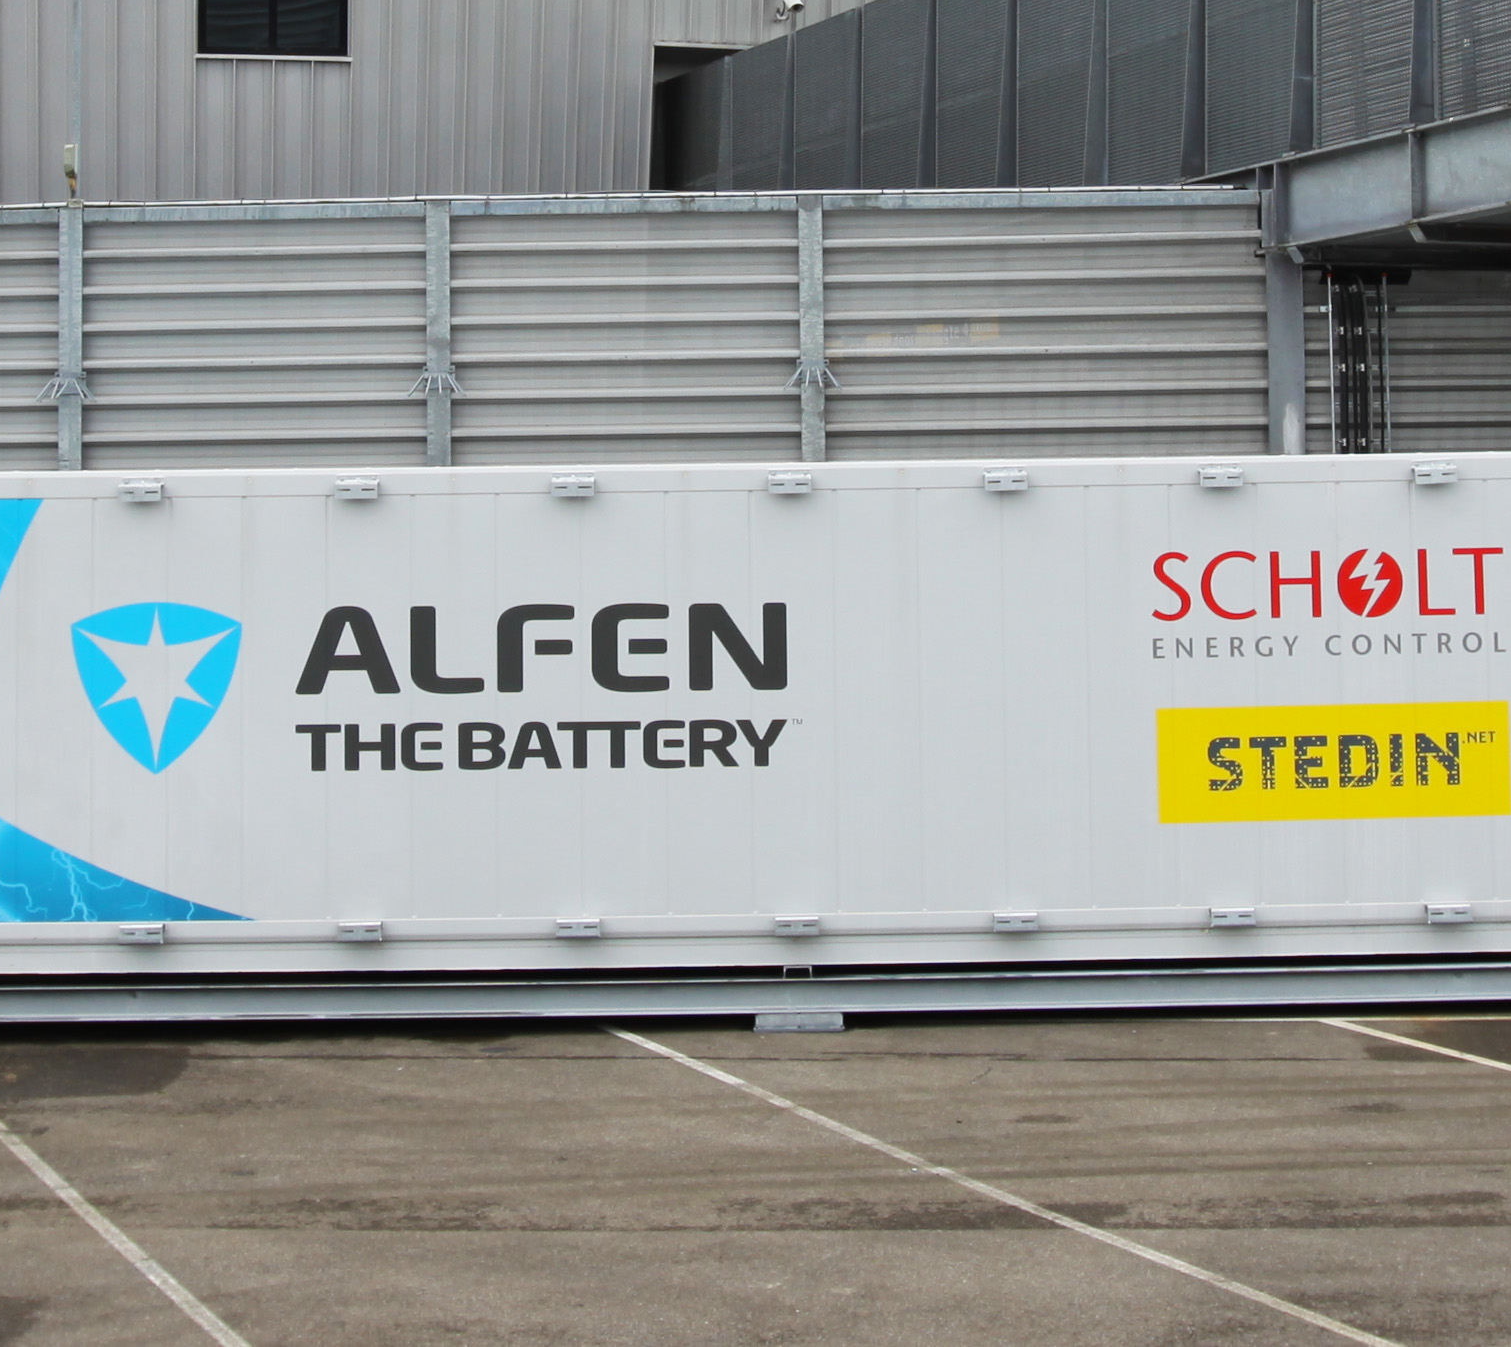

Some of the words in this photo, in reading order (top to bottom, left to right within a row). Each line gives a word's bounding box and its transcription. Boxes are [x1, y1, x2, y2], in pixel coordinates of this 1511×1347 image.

[1152, 547, 1504, 622] SCHOLT
[295, 602, 789, 695] ALFEN
[1152, 635, 1299, 659] ENERGY
[1324, 631, 1507, 657] CONTROL
[295, 722, 445, 772] THE
[457, 719, 788, 771] BATTERY
[1207, 732, 1462, 792] STEDIN
